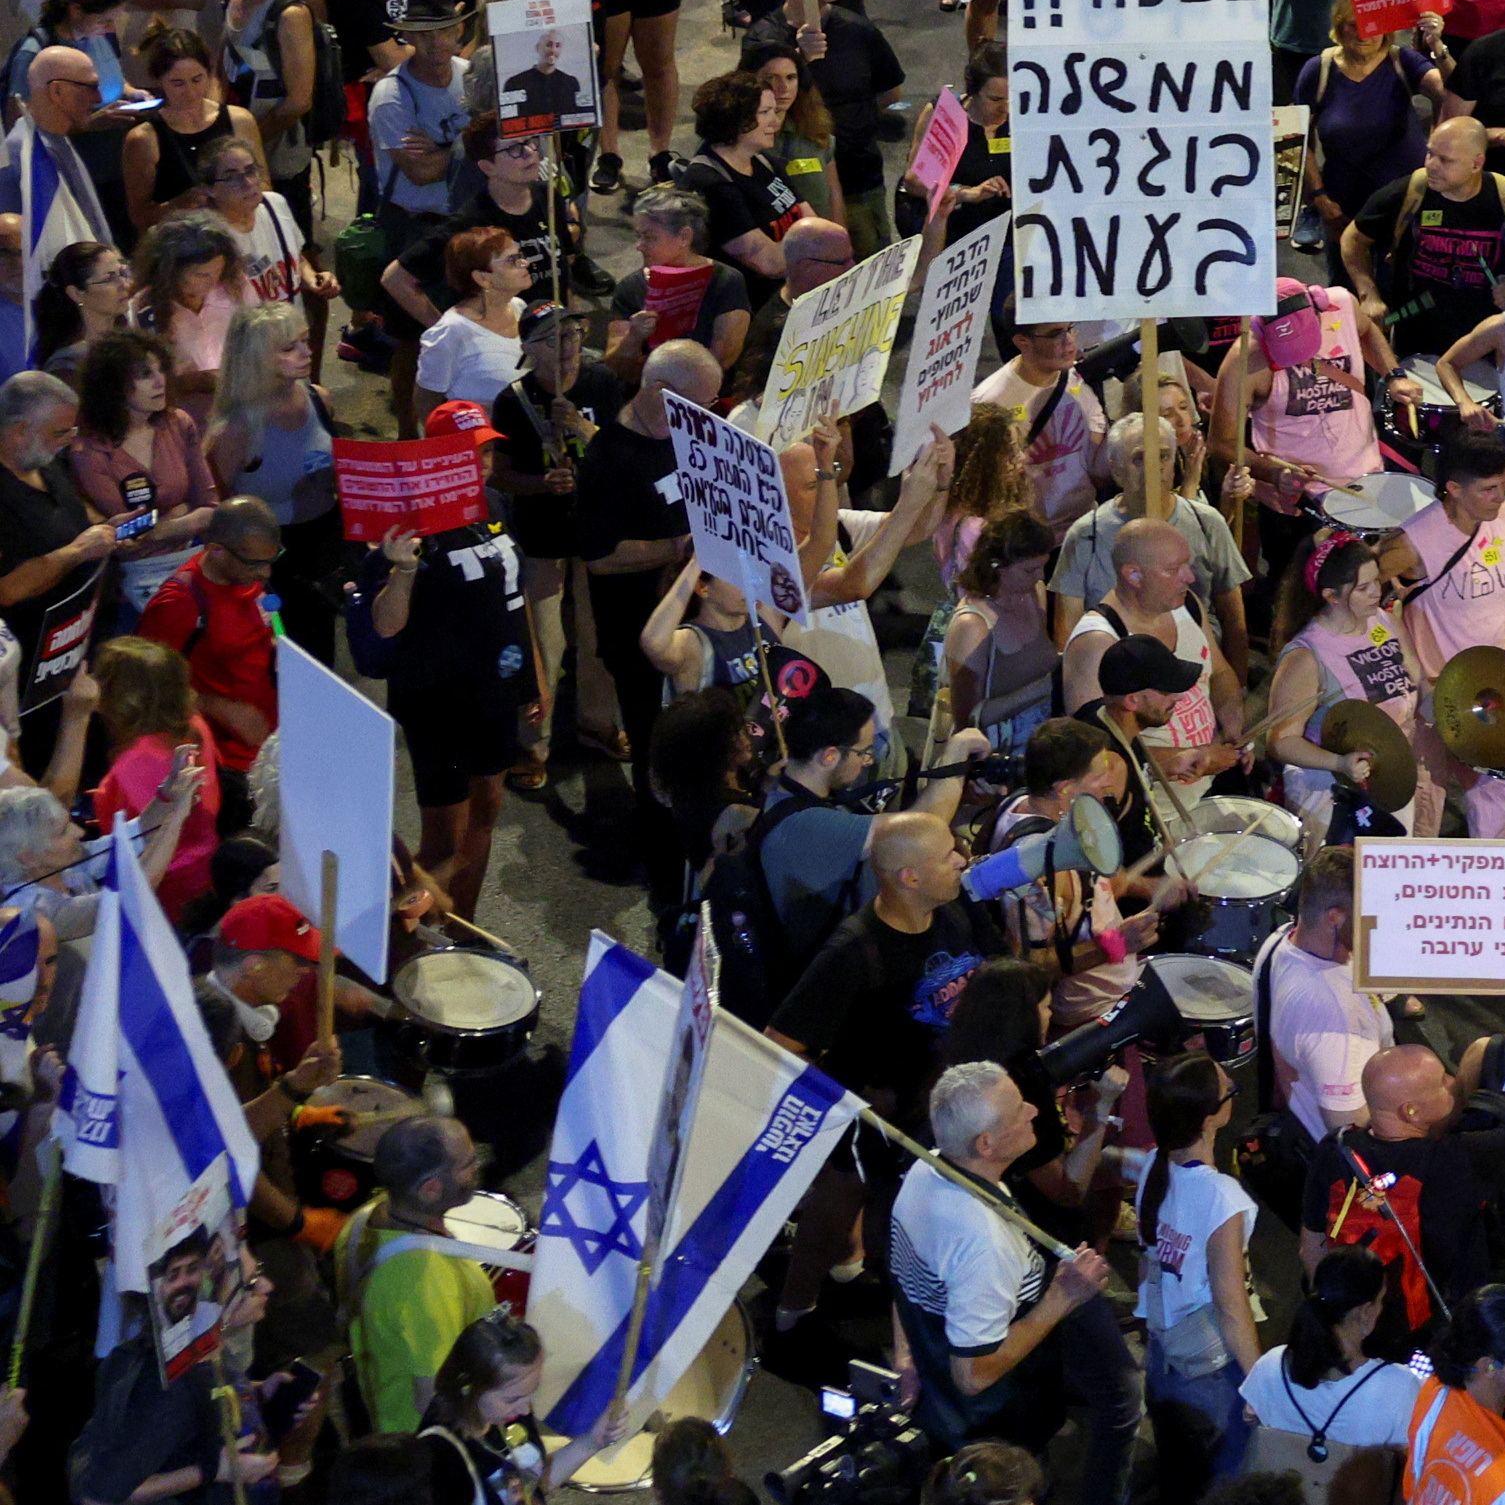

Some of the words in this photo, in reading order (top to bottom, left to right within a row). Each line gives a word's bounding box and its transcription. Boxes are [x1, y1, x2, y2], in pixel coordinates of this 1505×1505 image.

[1013, 53, 1253, 116] ממשלה
[1029, 127, 1260, 197] בוגדת
[946, 234, 991, 274] הדבר
[1015, 213, 1258, 299] בעמה
[1306, 396, 1340, 412] DEAL
[1350, 639, 1400, 664] VICTOR
[1367, 663, 1406, 684] HOSTA
[1395, 882, 1492, 903] החטופים,
[1405, 914, 1493, 934] הנתינים,
[1420, 939, 1487, 957] ערובה
